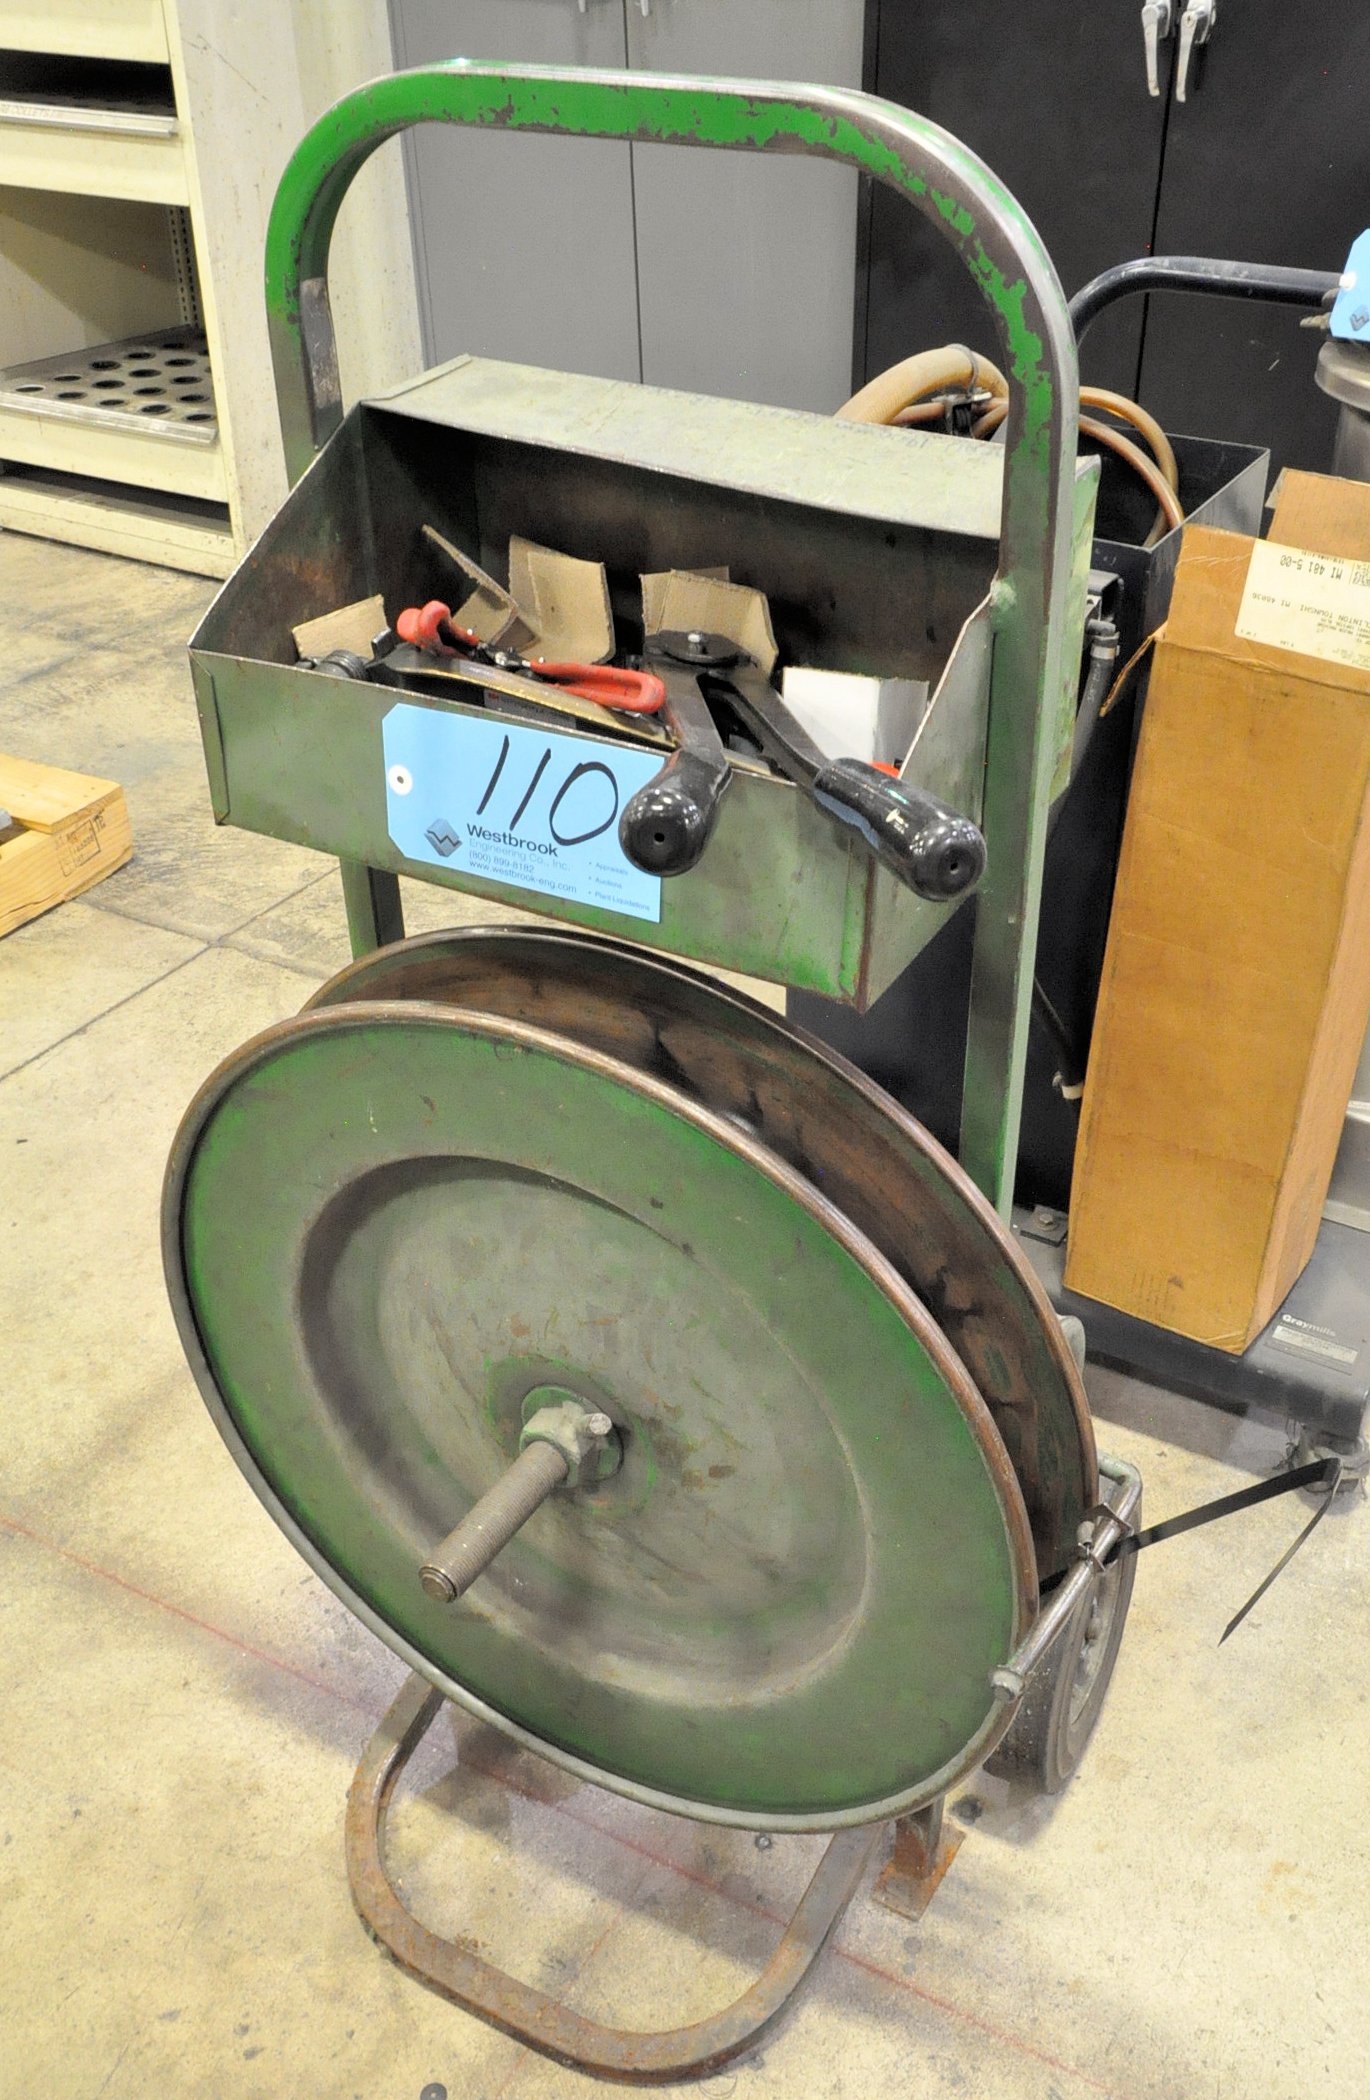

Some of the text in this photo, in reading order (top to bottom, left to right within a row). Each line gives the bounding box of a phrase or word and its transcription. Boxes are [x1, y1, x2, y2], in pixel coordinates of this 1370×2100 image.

[477, 735, 619, 846] 110
[466, 822, 558, 857] Westbrook
[469, 838, 527, 863] Engineering
[469, 850, 535, 874] (800) 899-8182
[469, 860, 577, 894] www.westbrook-eng.com
[1282, 1313, 1336, 1337] Graymills
